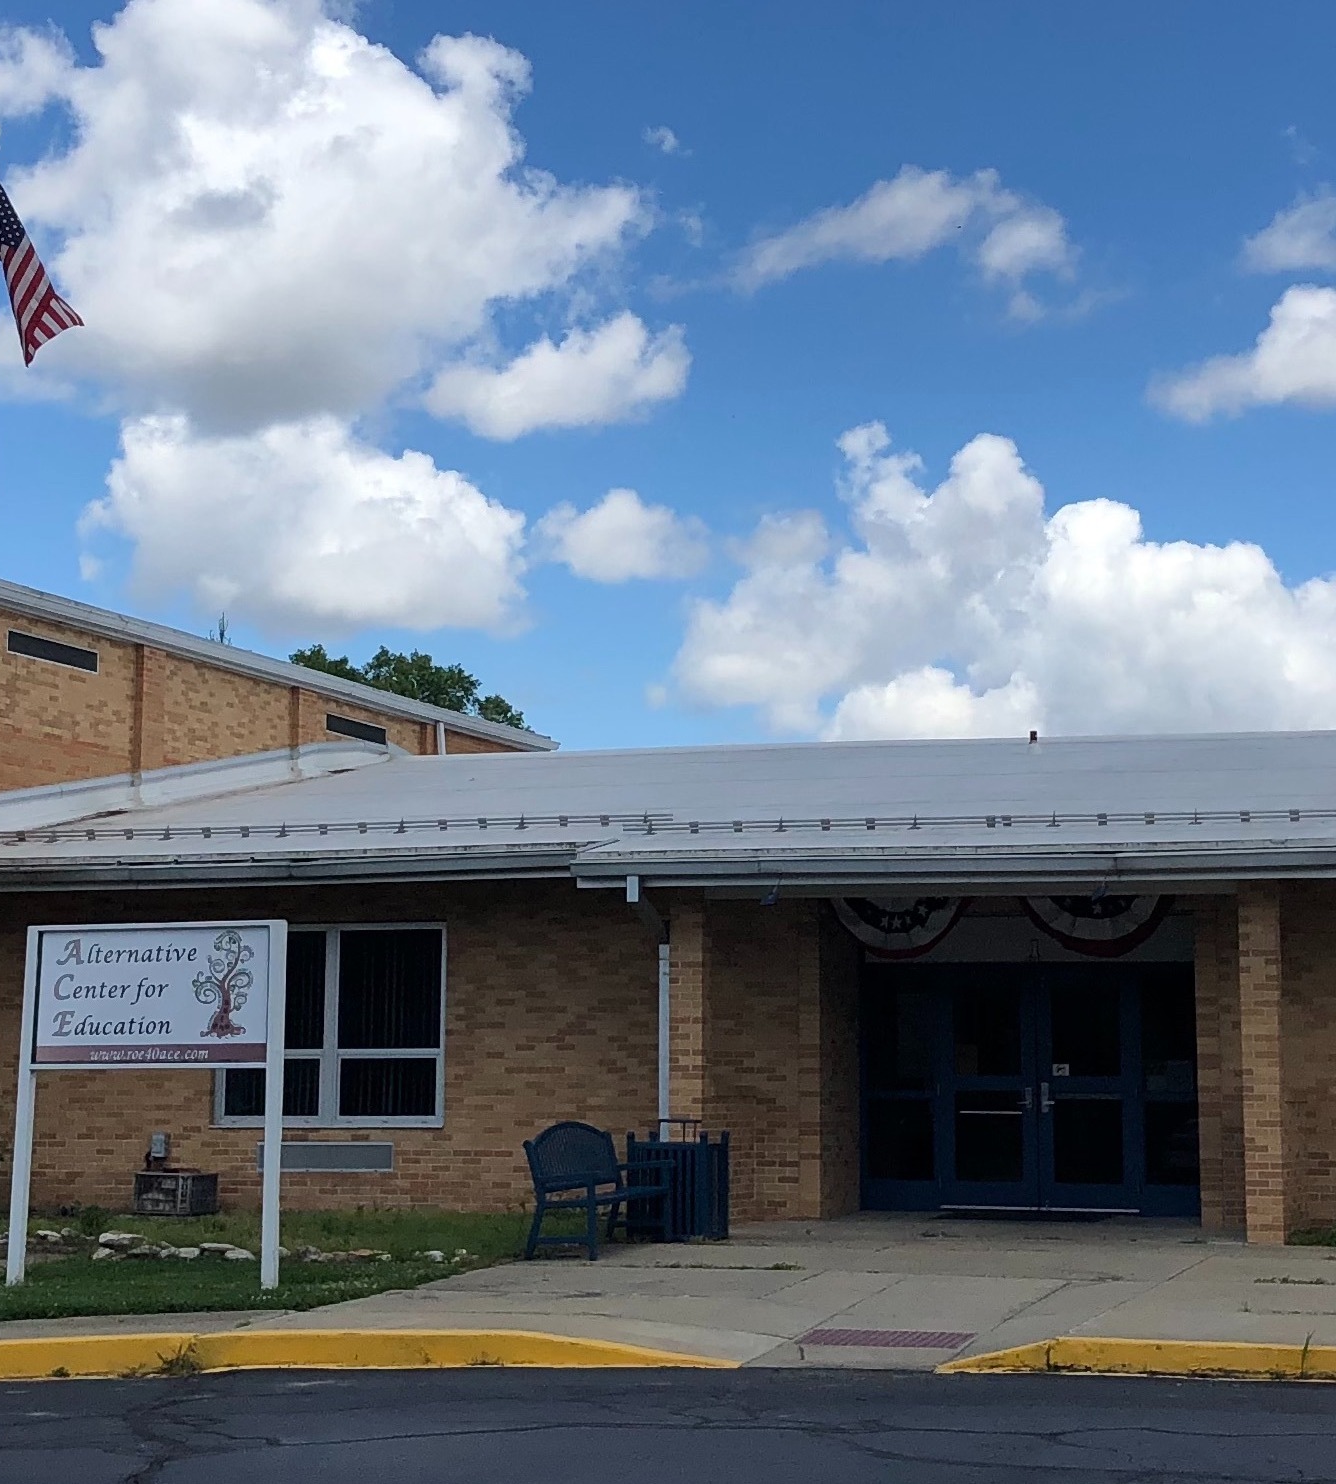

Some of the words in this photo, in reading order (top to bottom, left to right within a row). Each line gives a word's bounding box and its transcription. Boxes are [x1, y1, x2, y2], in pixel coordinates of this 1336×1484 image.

[55, 938, 198, 966] Alternative
[53, 974, 131, 1001] Center
[130, 977, 170, 1005] for
[51, 1010, 172, 1038] Education
[89, 1047, 209, 1062] www.roe40ace.com
